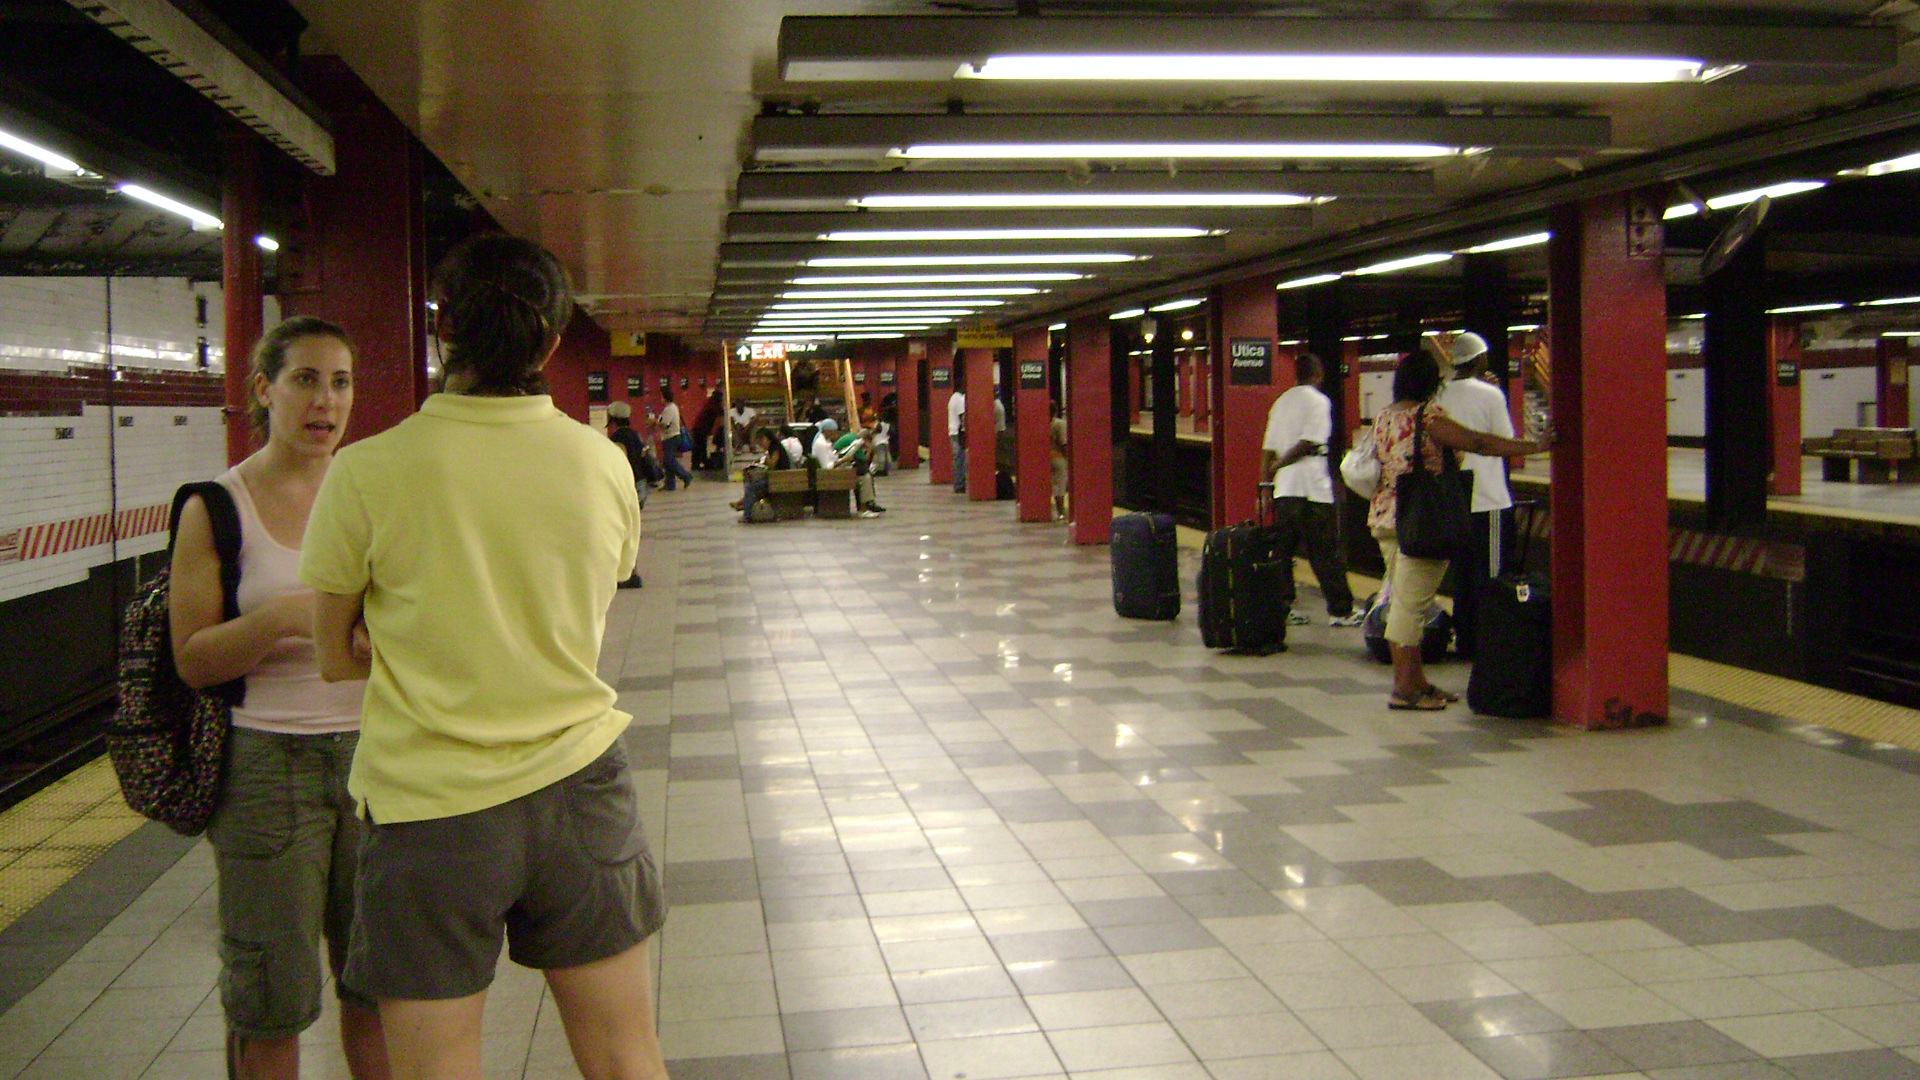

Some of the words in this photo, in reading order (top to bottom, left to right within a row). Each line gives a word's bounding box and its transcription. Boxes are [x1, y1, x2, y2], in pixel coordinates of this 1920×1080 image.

[750, 343, 784, 360] Exit
[786, 343, 806, 352] Utica
[1232, 344, 1265, 357] Utica
